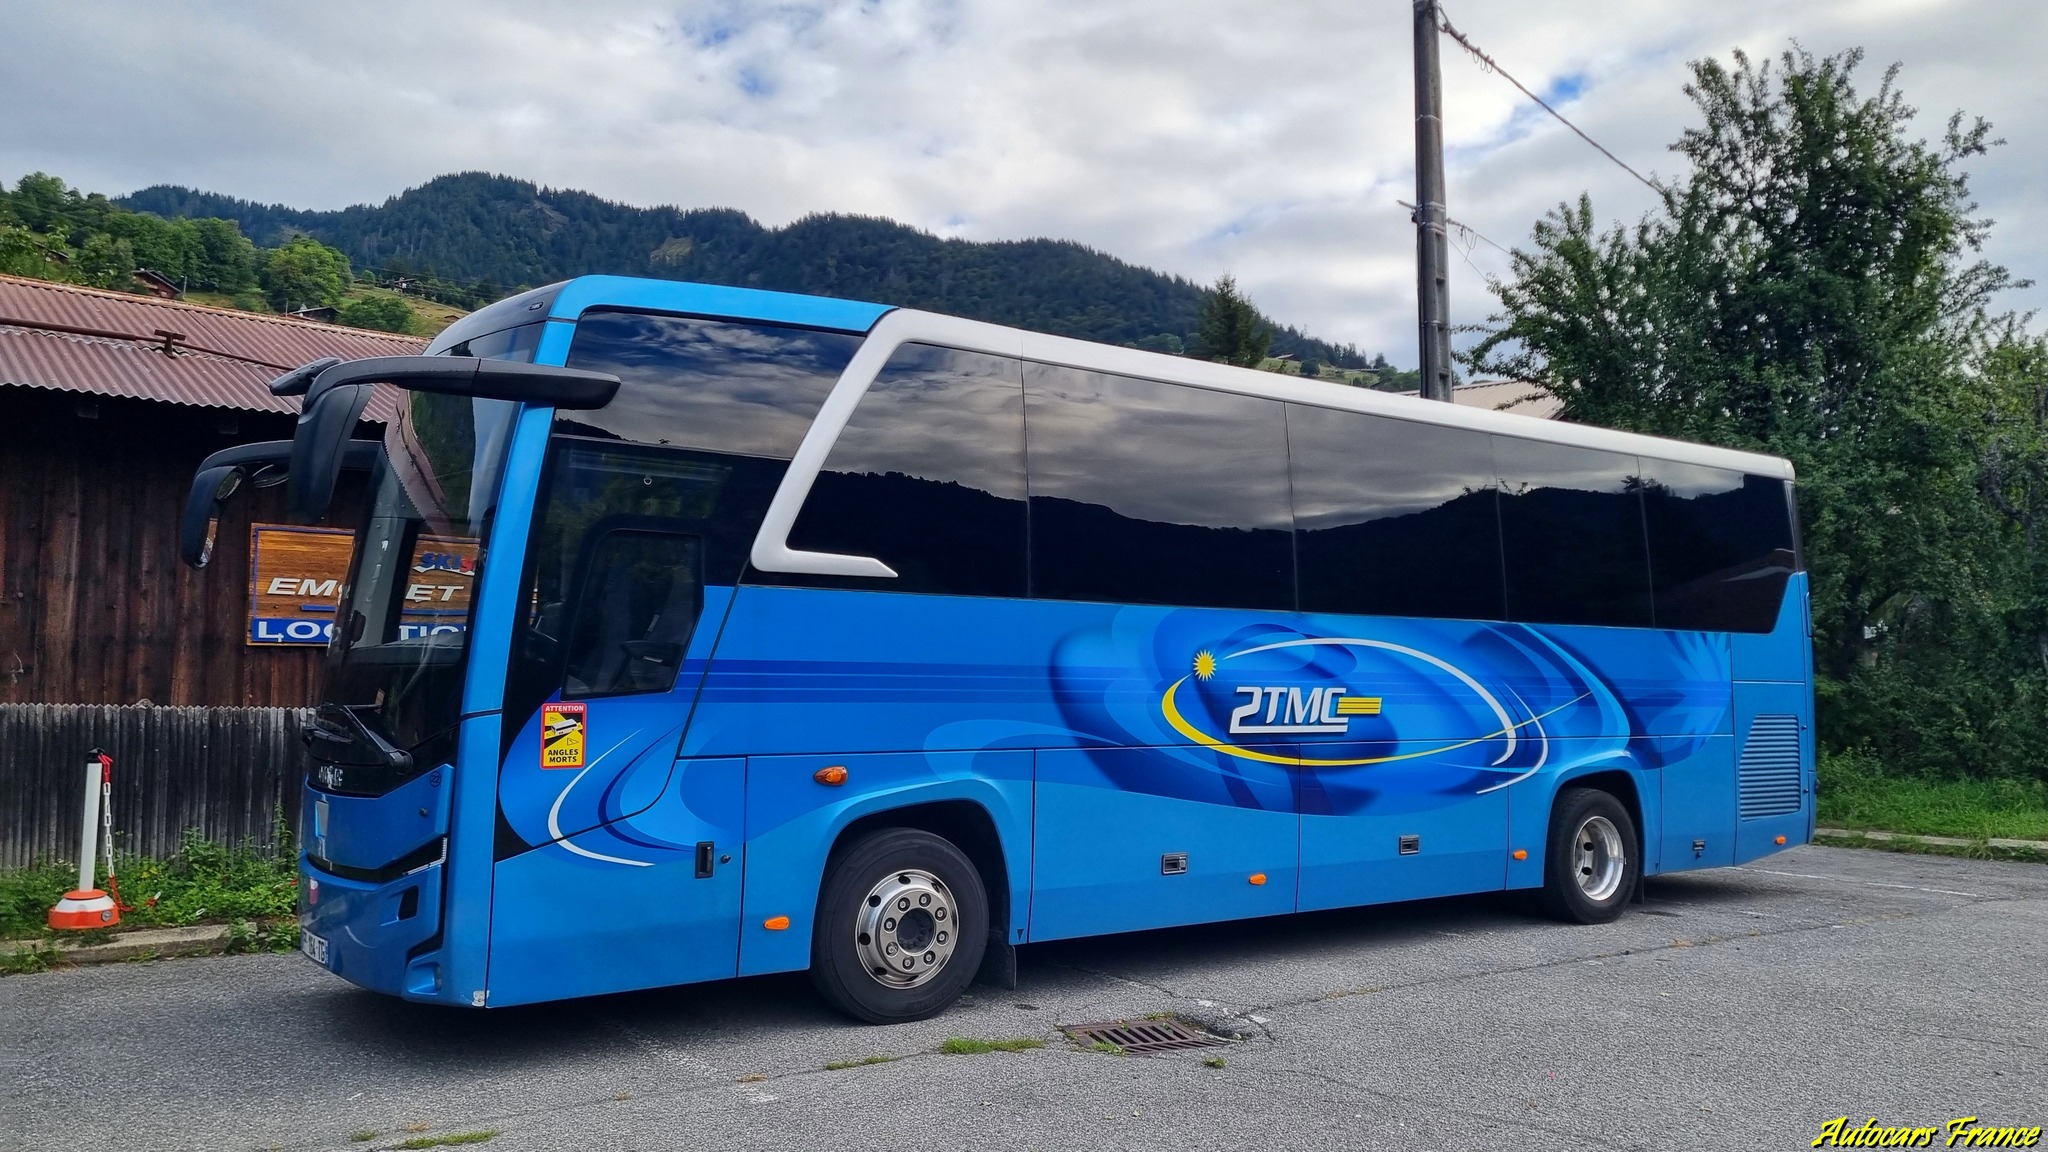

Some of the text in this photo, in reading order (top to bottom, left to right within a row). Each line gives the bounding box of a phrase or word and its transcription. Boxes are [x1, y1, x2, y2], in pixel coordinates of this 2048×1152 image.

[421, 552, 476, 573] SKIS
[1229, 687, 1349, 734] 2TMC
[548, 748, 579, 756] ANGLES
